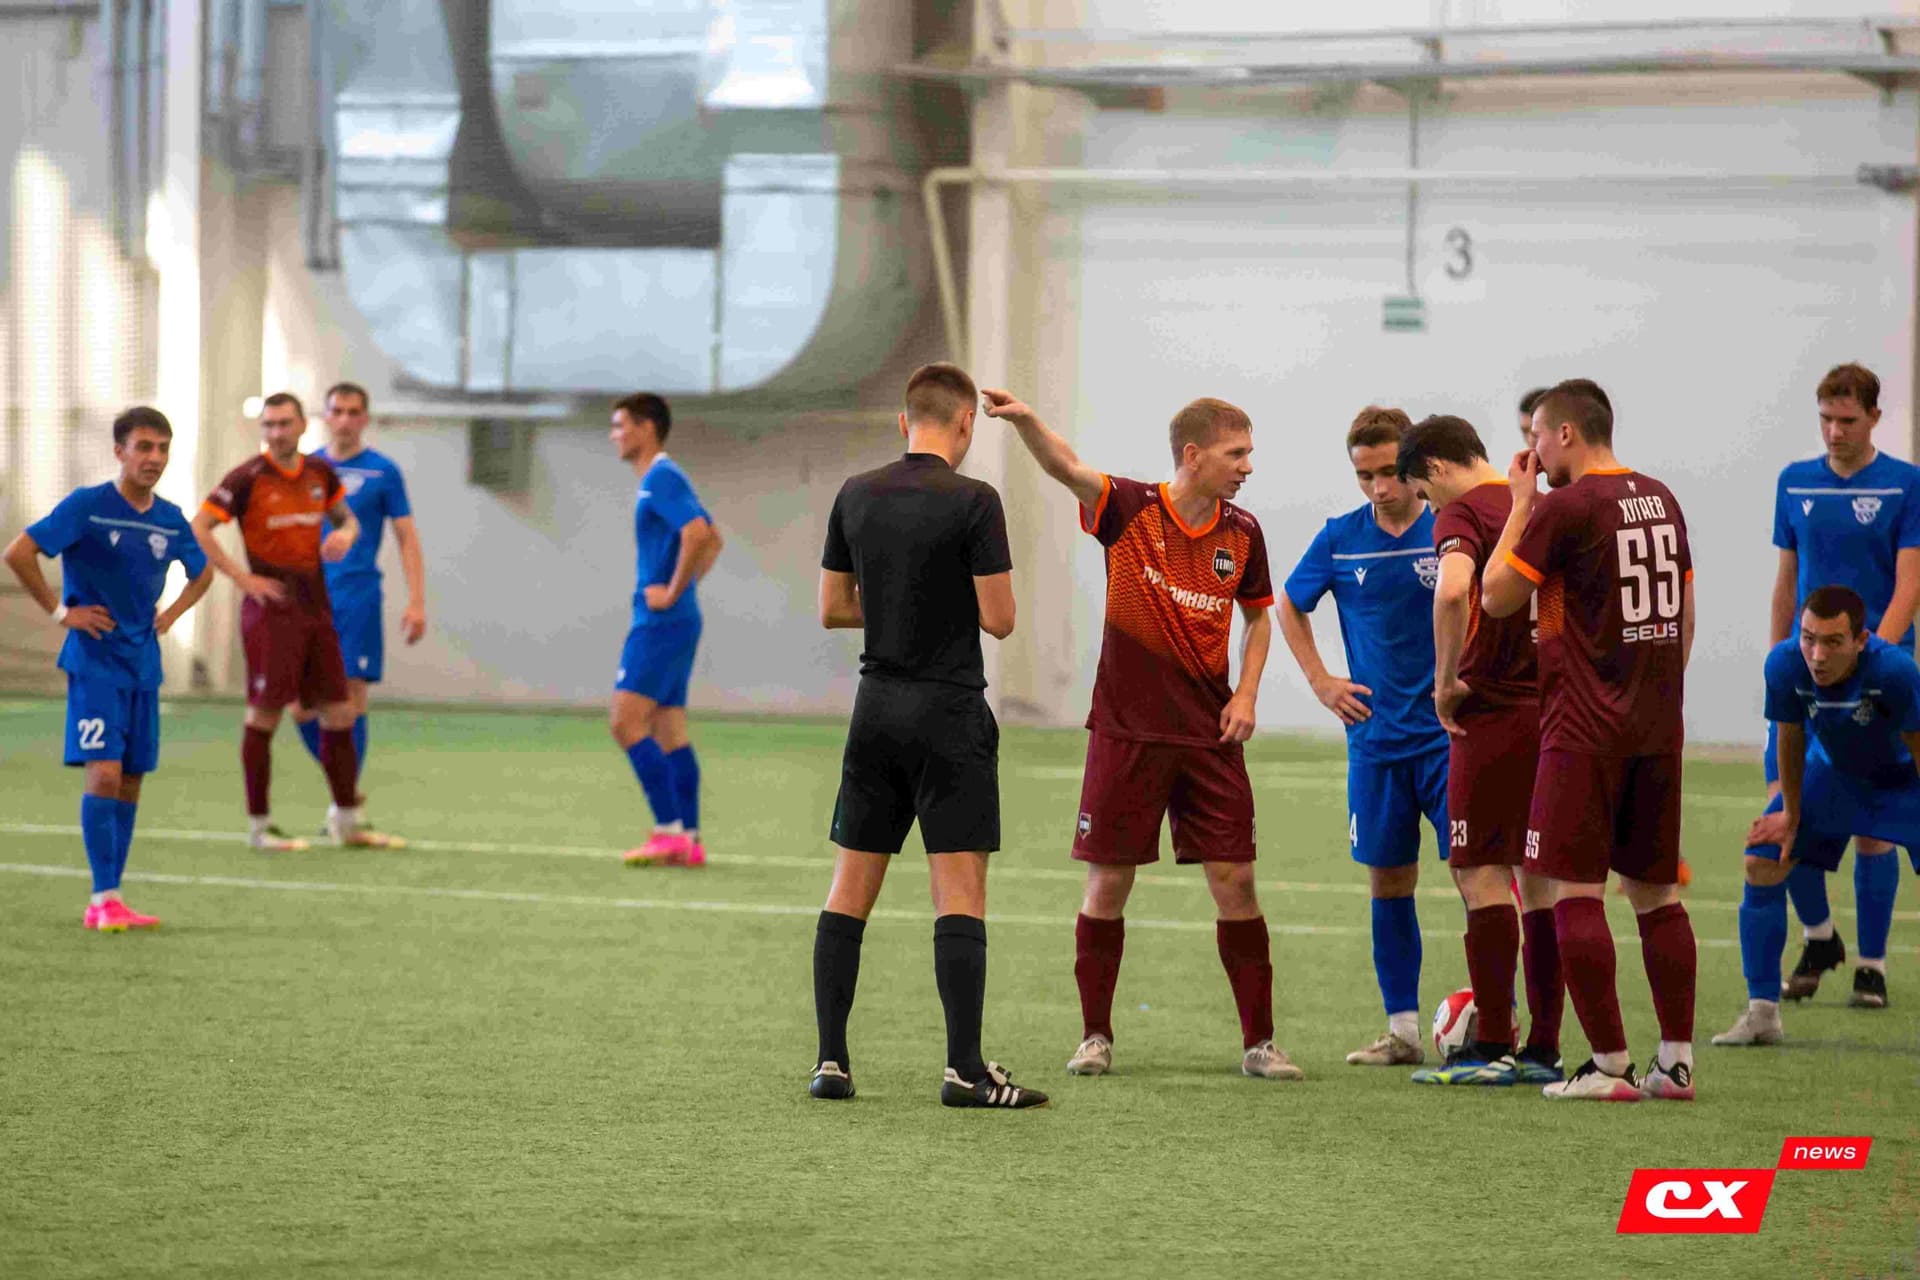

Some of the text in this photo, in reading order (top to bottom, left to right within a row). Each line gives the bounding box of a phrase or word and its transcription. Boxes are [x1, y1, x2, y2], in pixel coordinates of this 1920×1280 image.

[1444, 227, 1474, 279] 3
[1618, 496, 1666, 524] ХУГАЕВ
[1616, 524, 1680, 622] 55
[1622, 621, 1678, 643] SEUS
[78, 718, 105, 750] 22
[1451, 820, 1467, 847] 23
[1526, 830, 1540, 859] 55
